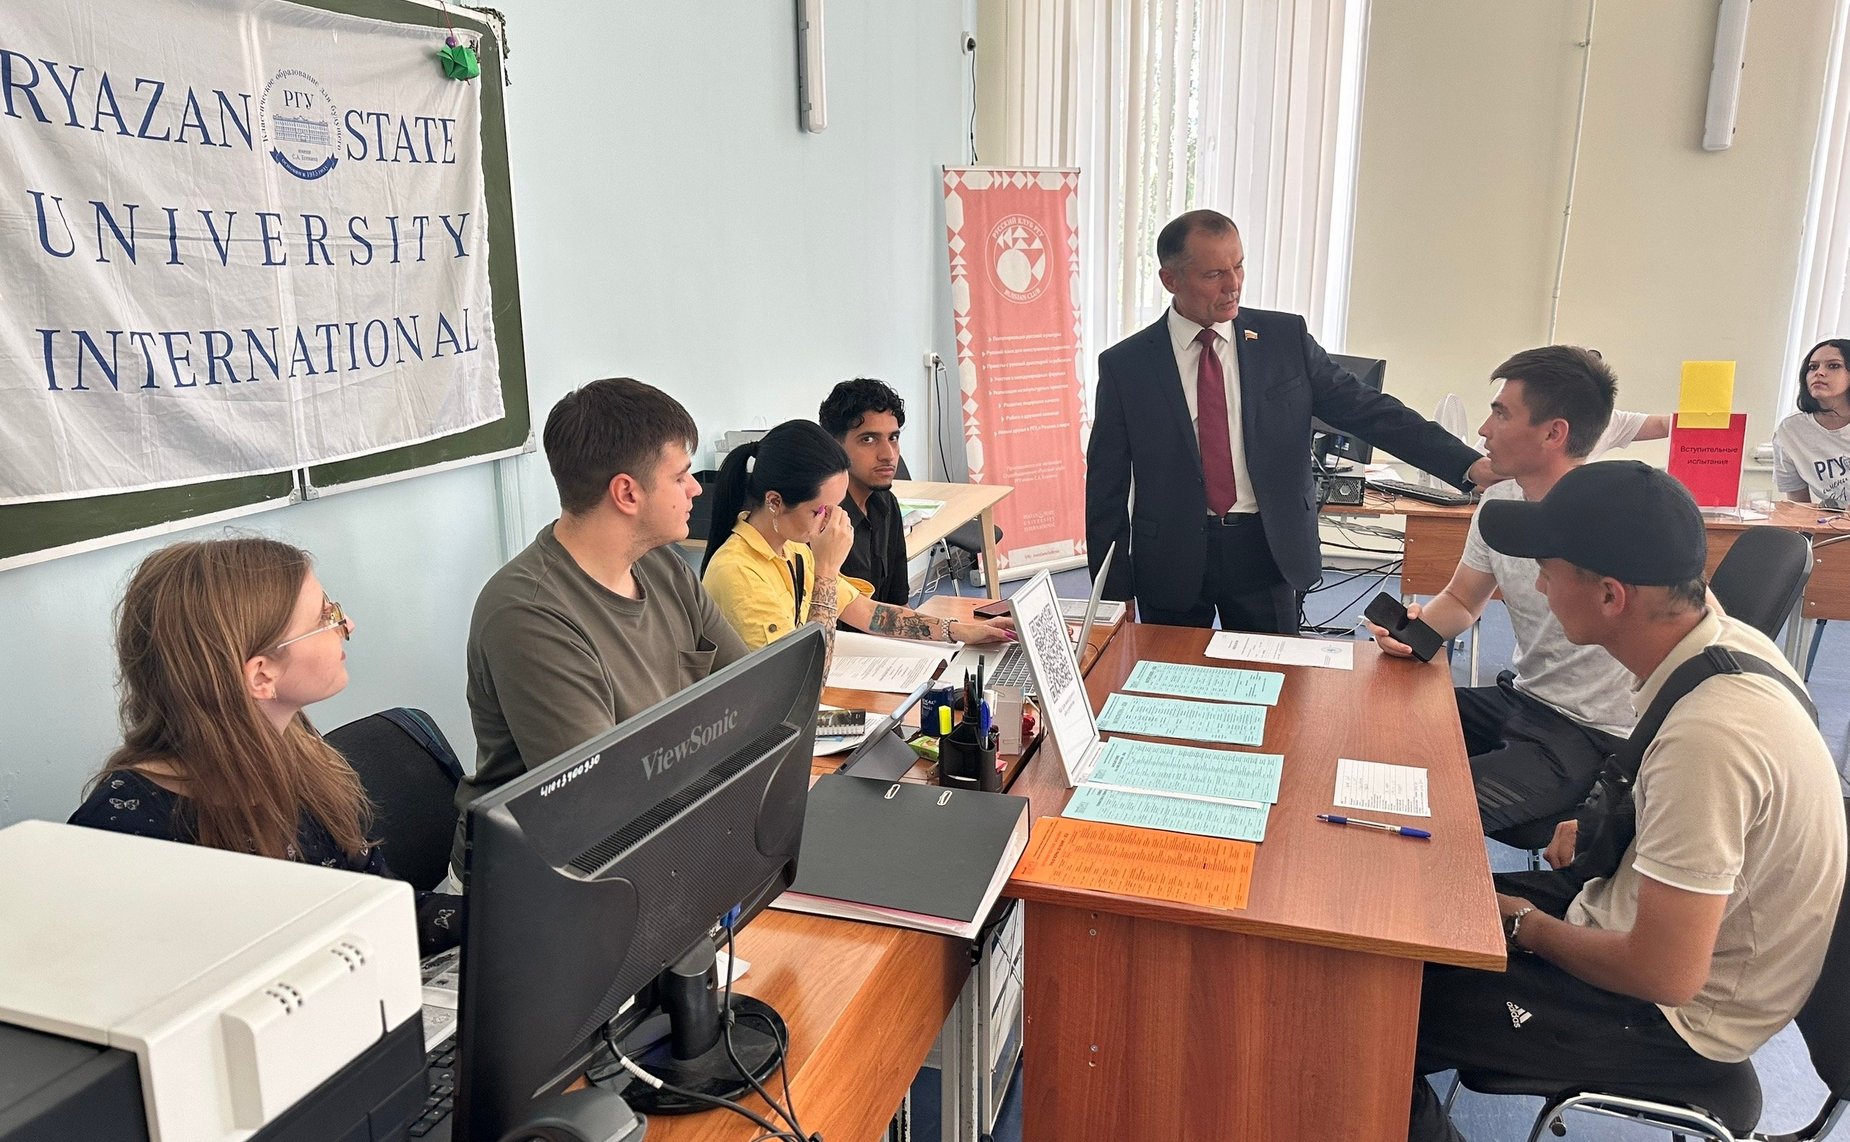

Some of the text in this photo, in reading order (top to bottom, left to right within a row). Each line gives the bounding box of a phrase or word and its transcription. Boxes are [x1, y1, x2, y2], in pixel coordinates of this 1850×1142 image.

[275, 69, 320, 87] образование
[283, 89, 314, 110] РГУ
[0, 49, 457, 165] RYAZAN STATE
[26, 190, 470, 267] UNIVERSITY
[36, 308, 480, 391] INTERNATIONAL
[1680, 445, 1738, 453] Вступительные
[1814, 456, 1846, 481] РГУ
[641, 708, 738, 781] ViewSonic
